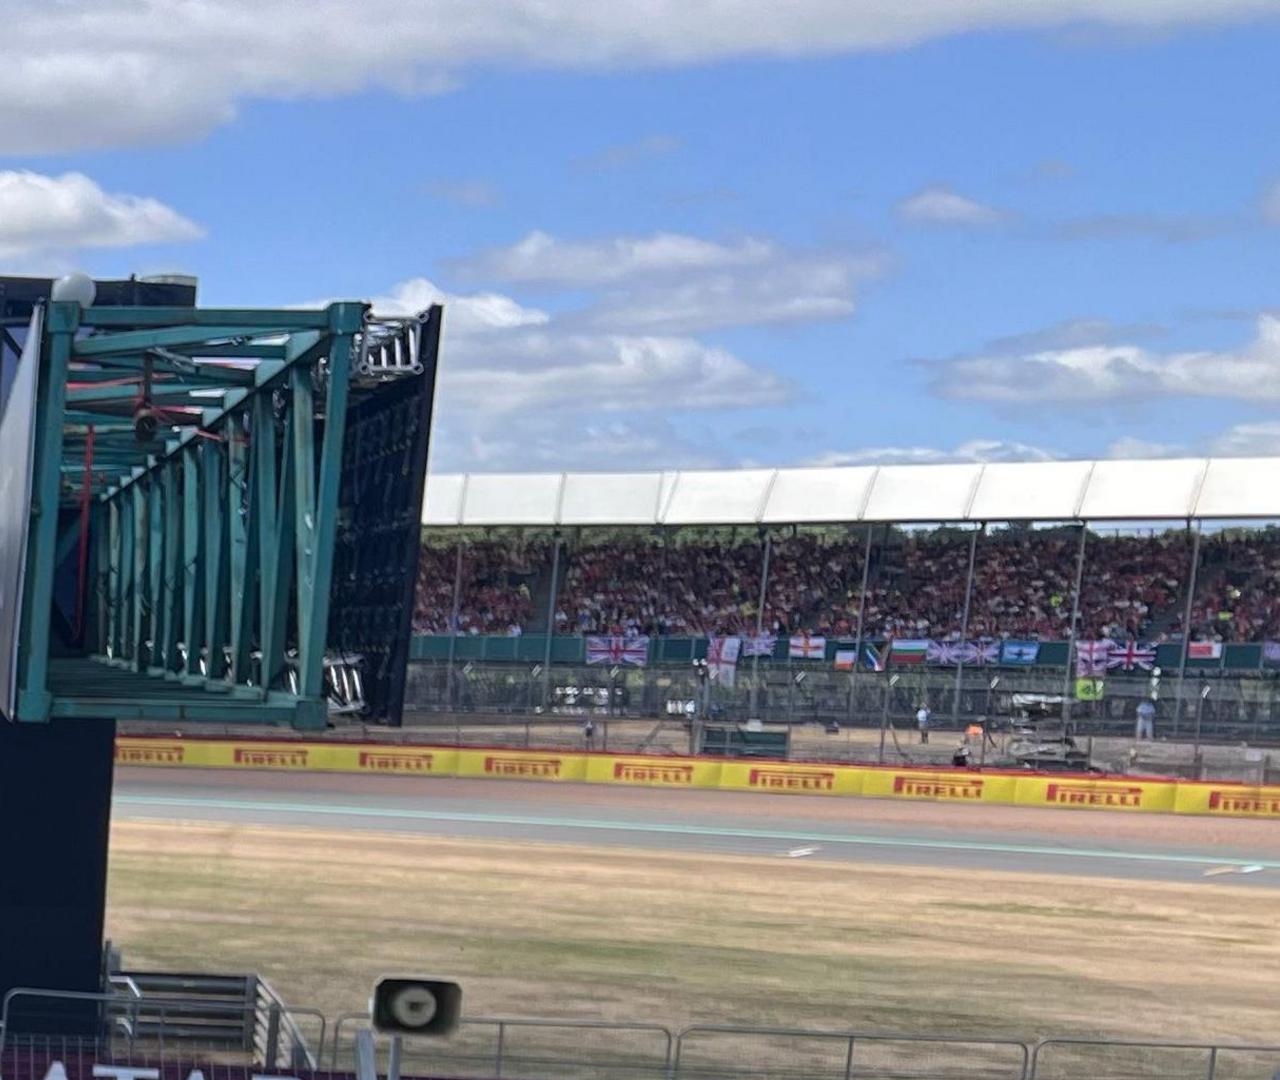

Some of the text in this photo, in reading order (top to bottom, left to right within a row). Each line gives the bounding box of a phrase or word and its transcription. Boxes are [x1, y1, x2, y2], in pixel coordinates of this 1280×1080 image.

[235, 748, 308, 766] PIRELLI
[359, 752, 433, 769] PIRELLI
[484, 757, 561, 776] PIRELLI
[613, 762, 693, 783] PIRELLI
[750, 768, 834, 790] PIRELLI
[894, 776, 984, 799] PIRELLI
[1047, 784, 1143, 806] PIRELLI
